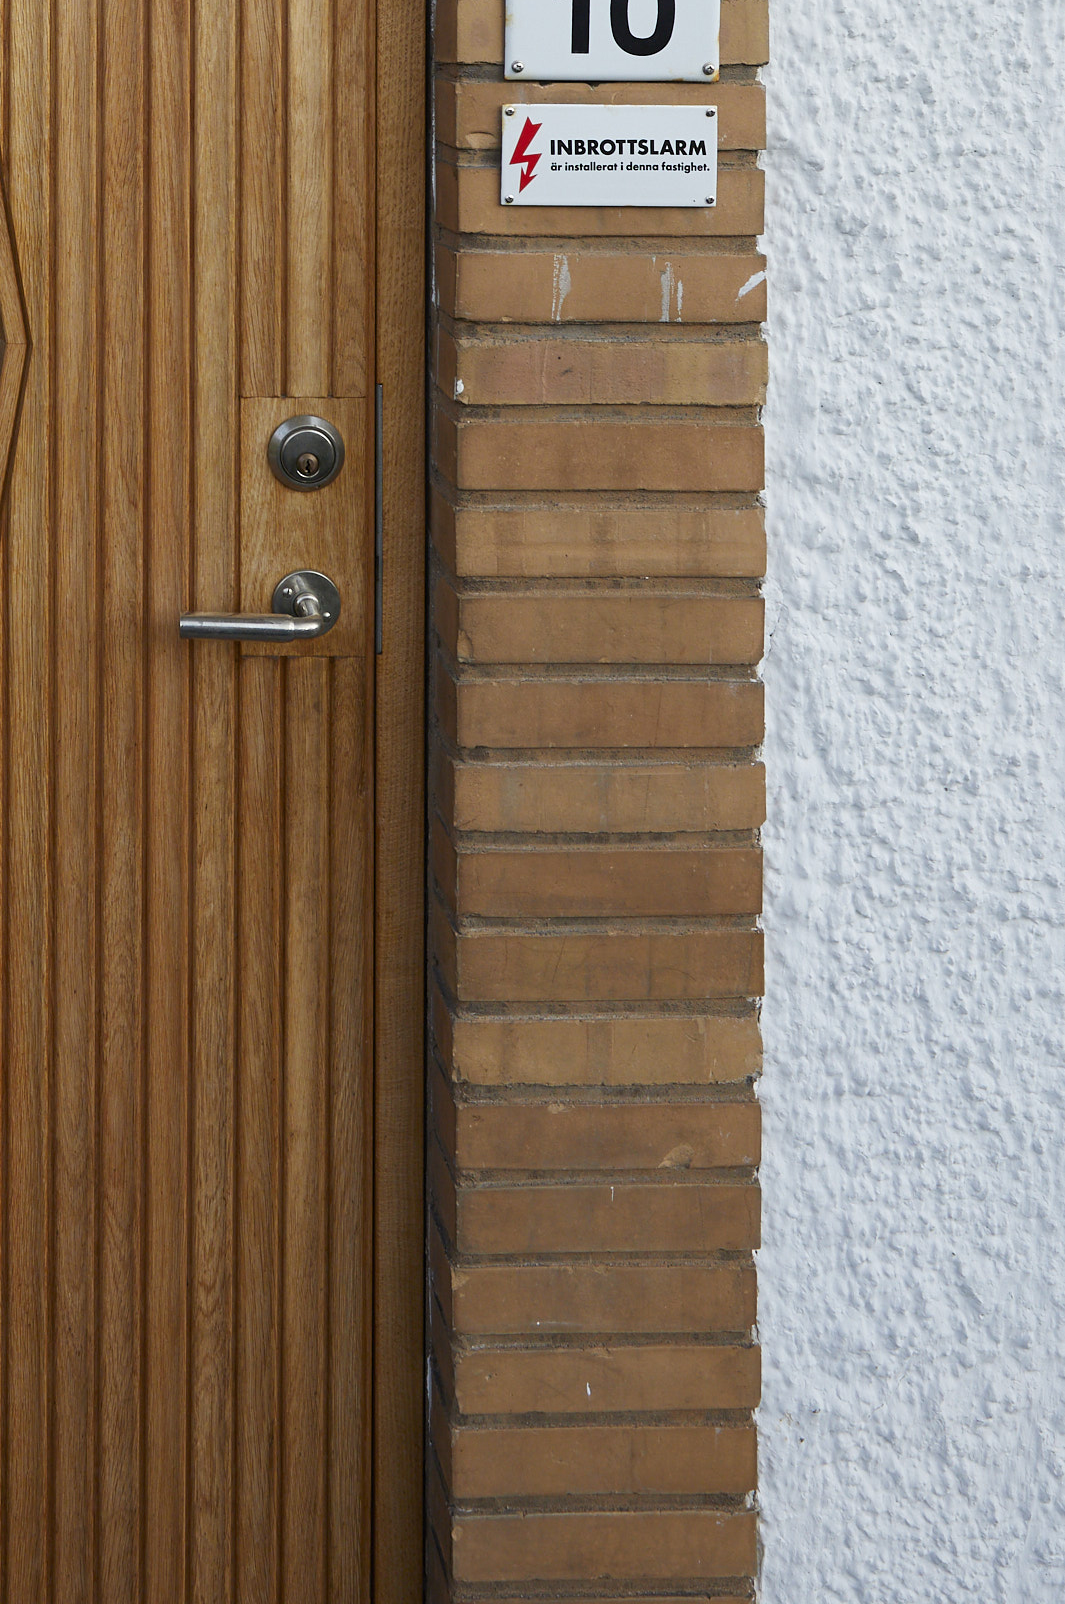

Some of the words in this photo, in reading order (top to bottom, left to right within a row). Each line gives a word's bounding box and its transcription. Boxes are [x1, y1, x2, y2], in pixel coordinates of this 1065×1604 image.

[550, 138, 707, 156] INBROTTSLARM
[550, 161, 562, 172] är
[564, 161, 618, 172] installerat
[620, 161, 624, 171] i
[625, 161, 659, 172] denna
[660, 161, 711, 174] fastighet.
